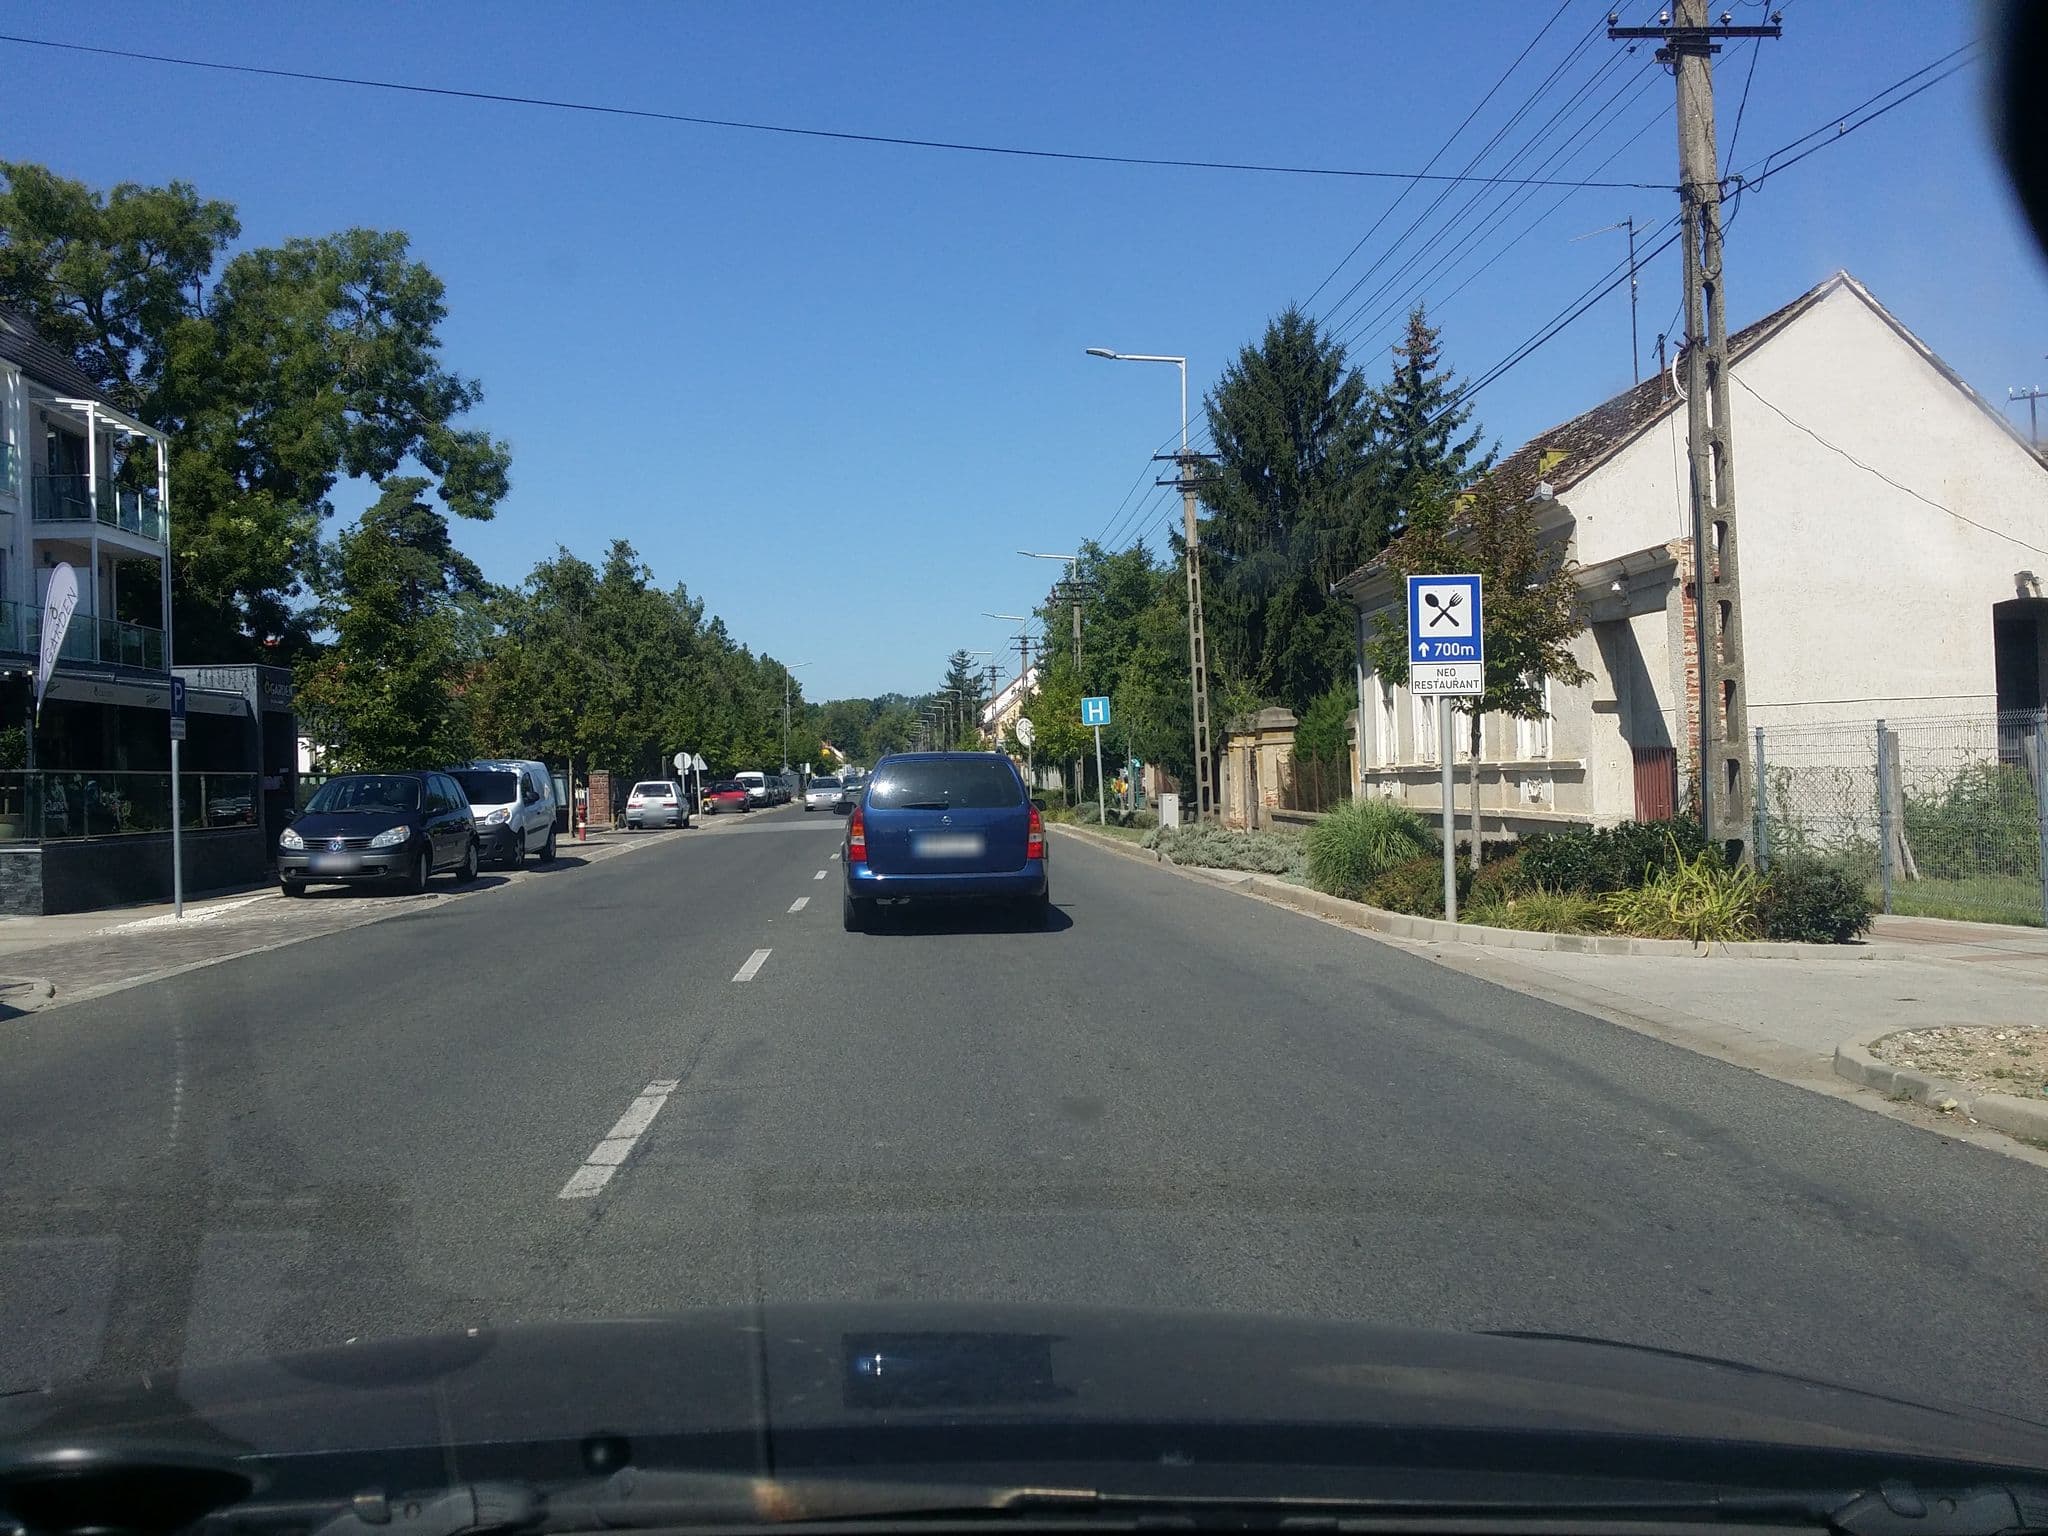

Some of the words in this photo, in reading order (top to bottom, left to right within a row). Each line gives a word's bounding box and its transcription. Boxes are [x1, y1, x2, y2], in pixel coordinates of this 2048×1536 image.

[45, 587, 78, 664] GARDEN
[1434, 642, 1474, 656] 700m
[1436, 668, 1456, 677] NEO
[1414, 680, 1480, 690] RESTAURANT
[174, 682, 183, 713] P
[1088, 701, 1103, 722] H
